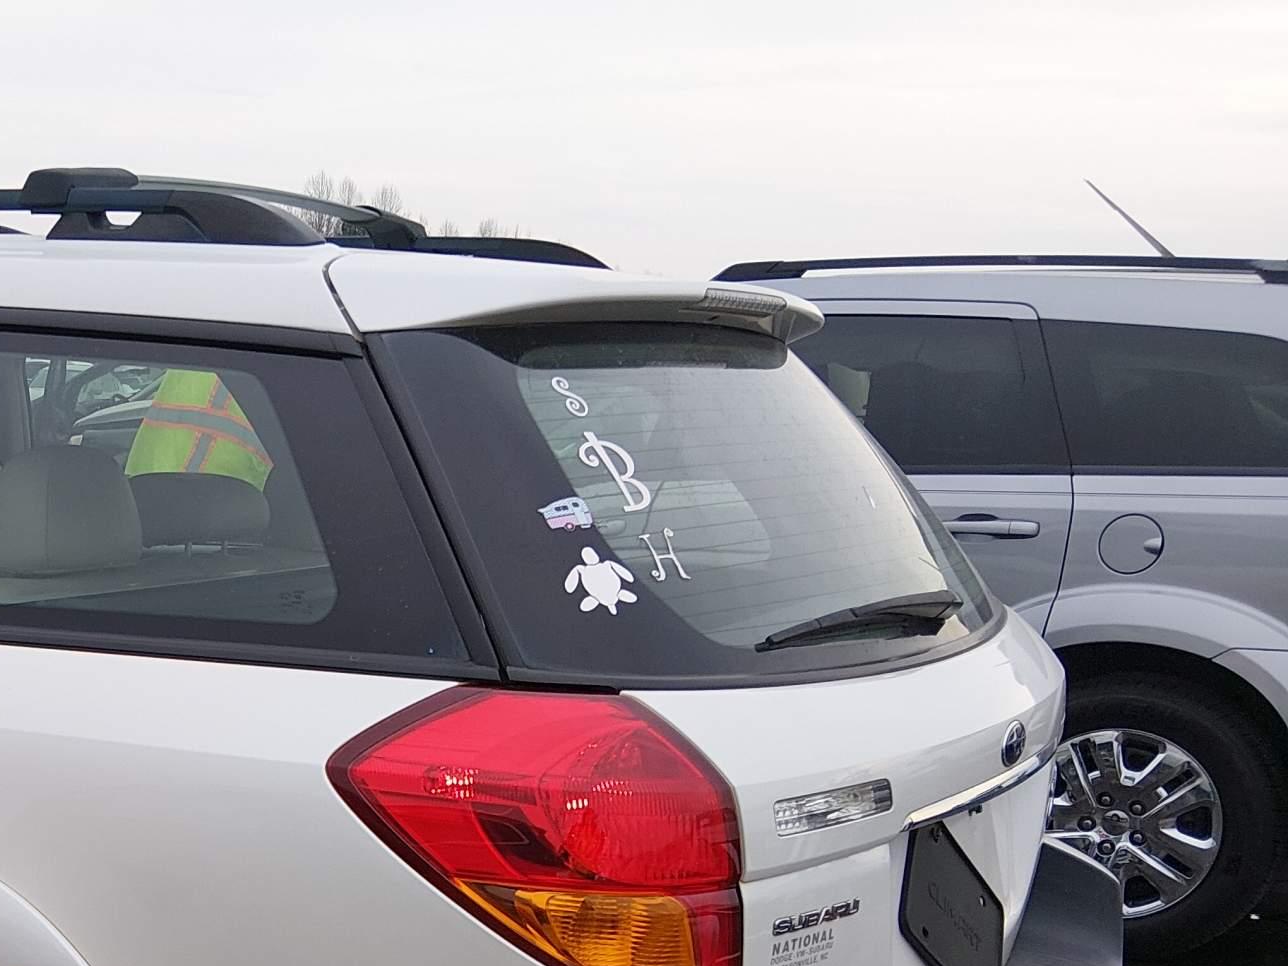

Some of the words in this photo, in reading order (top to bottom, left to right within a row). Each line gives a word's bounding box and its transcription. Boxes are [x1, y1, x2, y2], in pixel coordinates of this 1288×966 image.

[551, 376, 589, 417] S
[578, 431, 652, 512] B
[638, 527, 692, 582] H
[772, 898, 860, 937] SUBARU
[772, 928, 834, 957] NATIONAL
